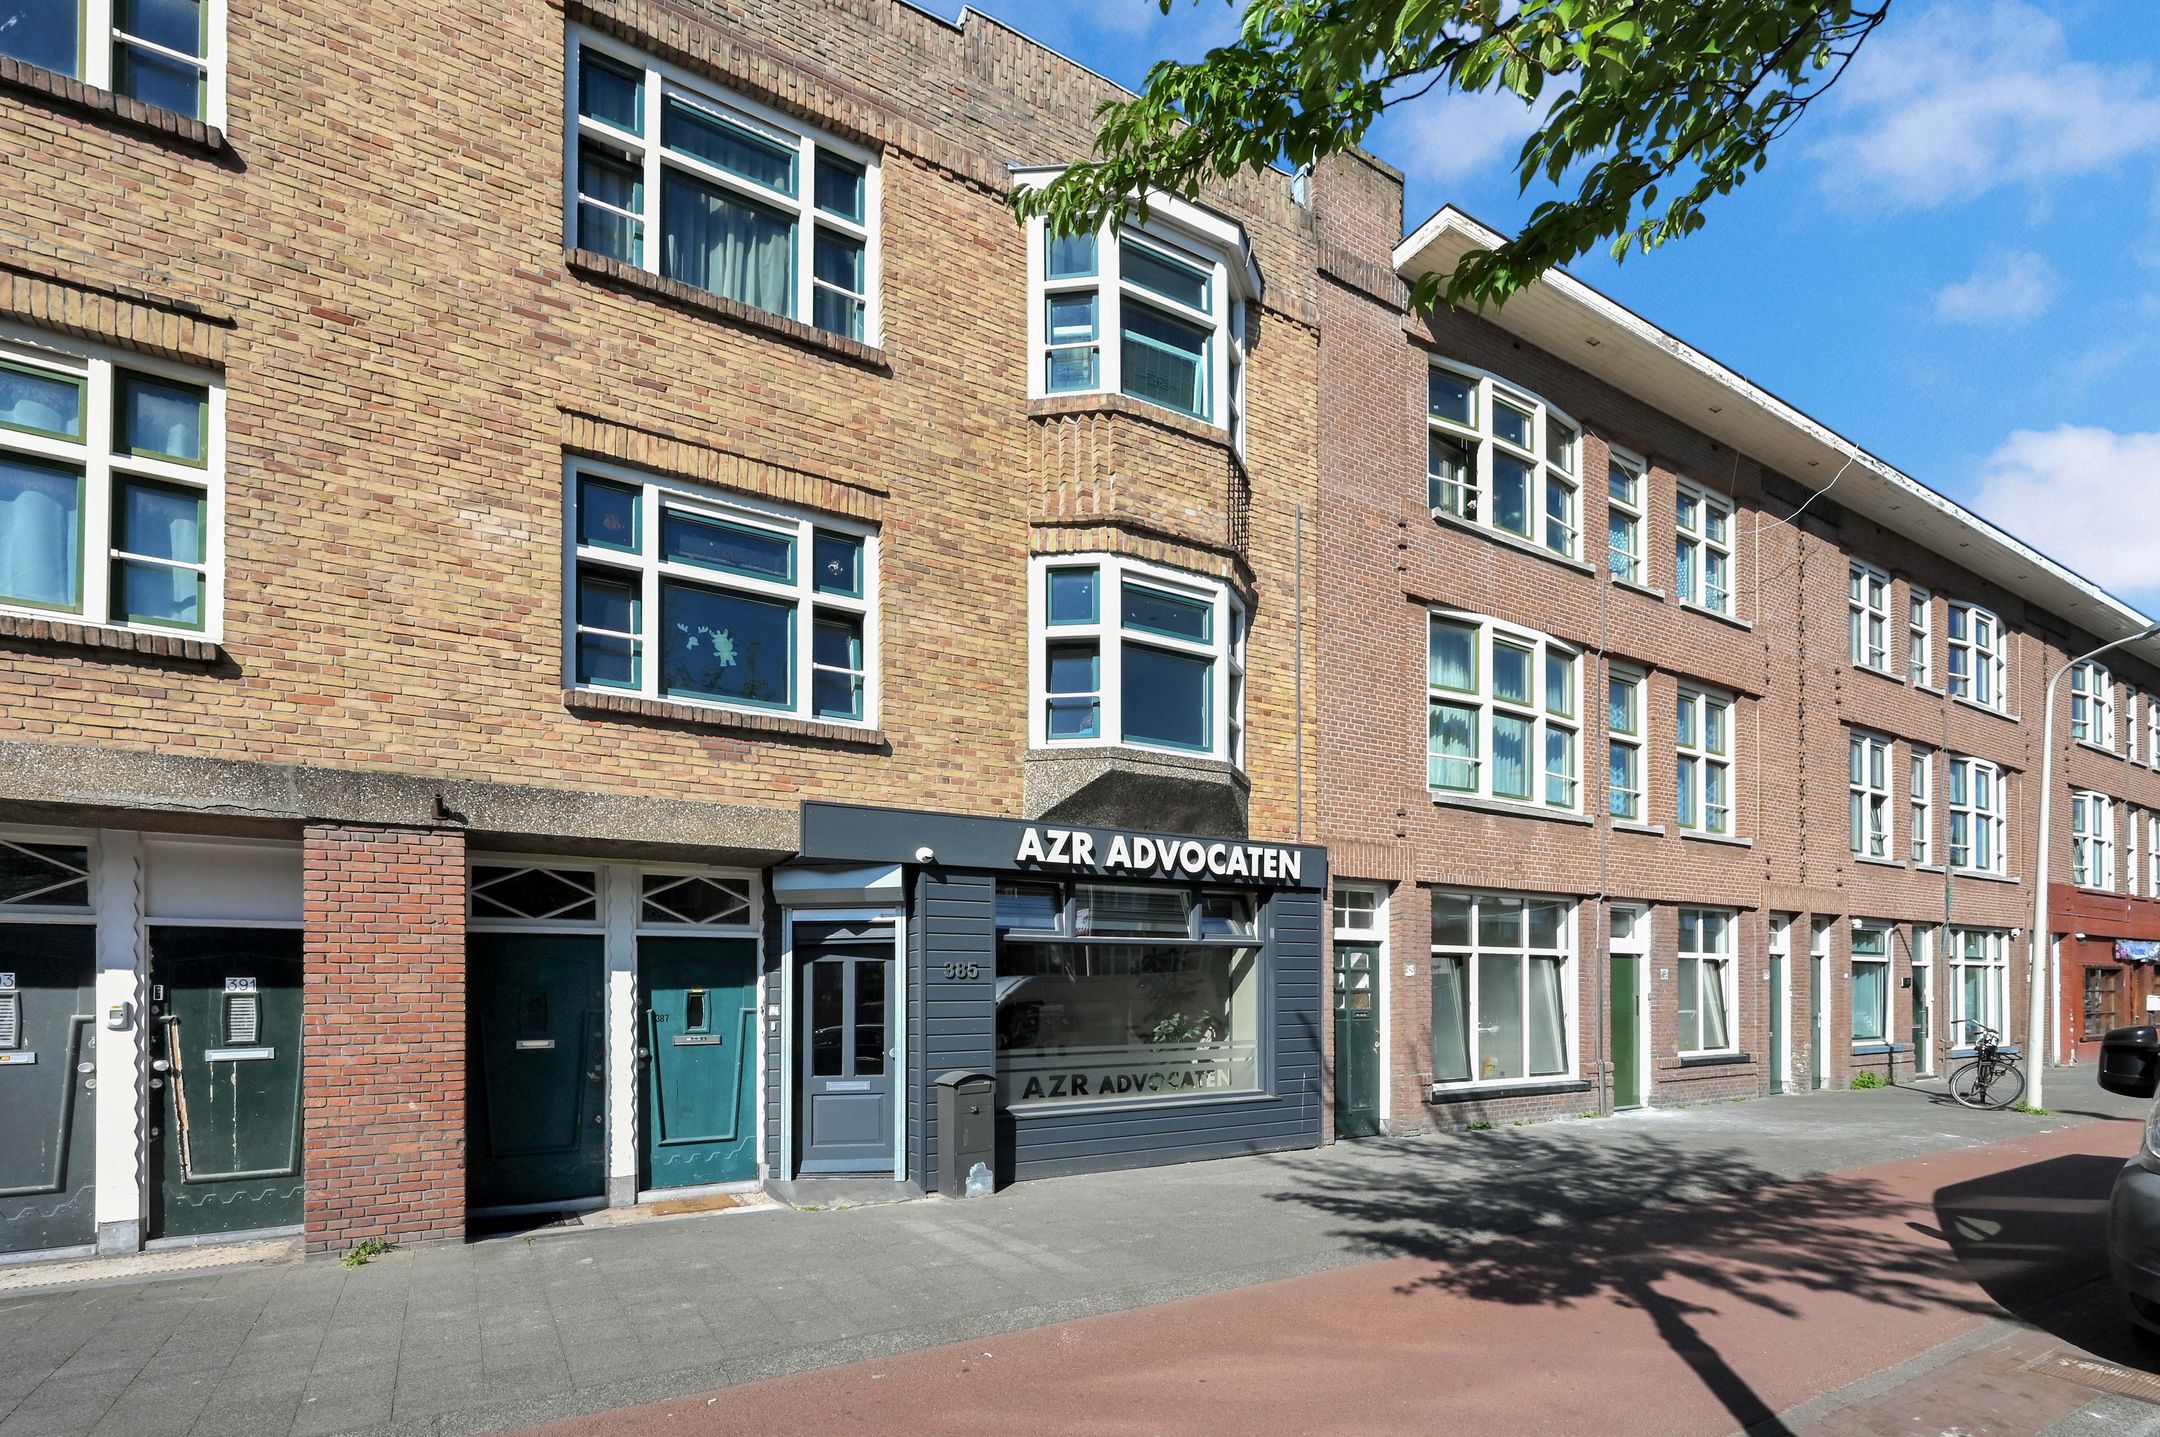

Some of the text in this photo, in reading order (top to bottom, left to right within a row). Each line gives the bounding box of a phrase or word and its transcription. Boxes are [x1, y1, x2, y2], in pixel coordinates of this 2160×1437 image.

[1016, 827, 1301, 880] AZR ADVOCATEN
[943, 961, 979, 979] 385
[0, 974, 14, 987] 3
[227, 978, 256, 991] 391
[1022, 1068, 1232, 1100] AZR ADVOCATEN
